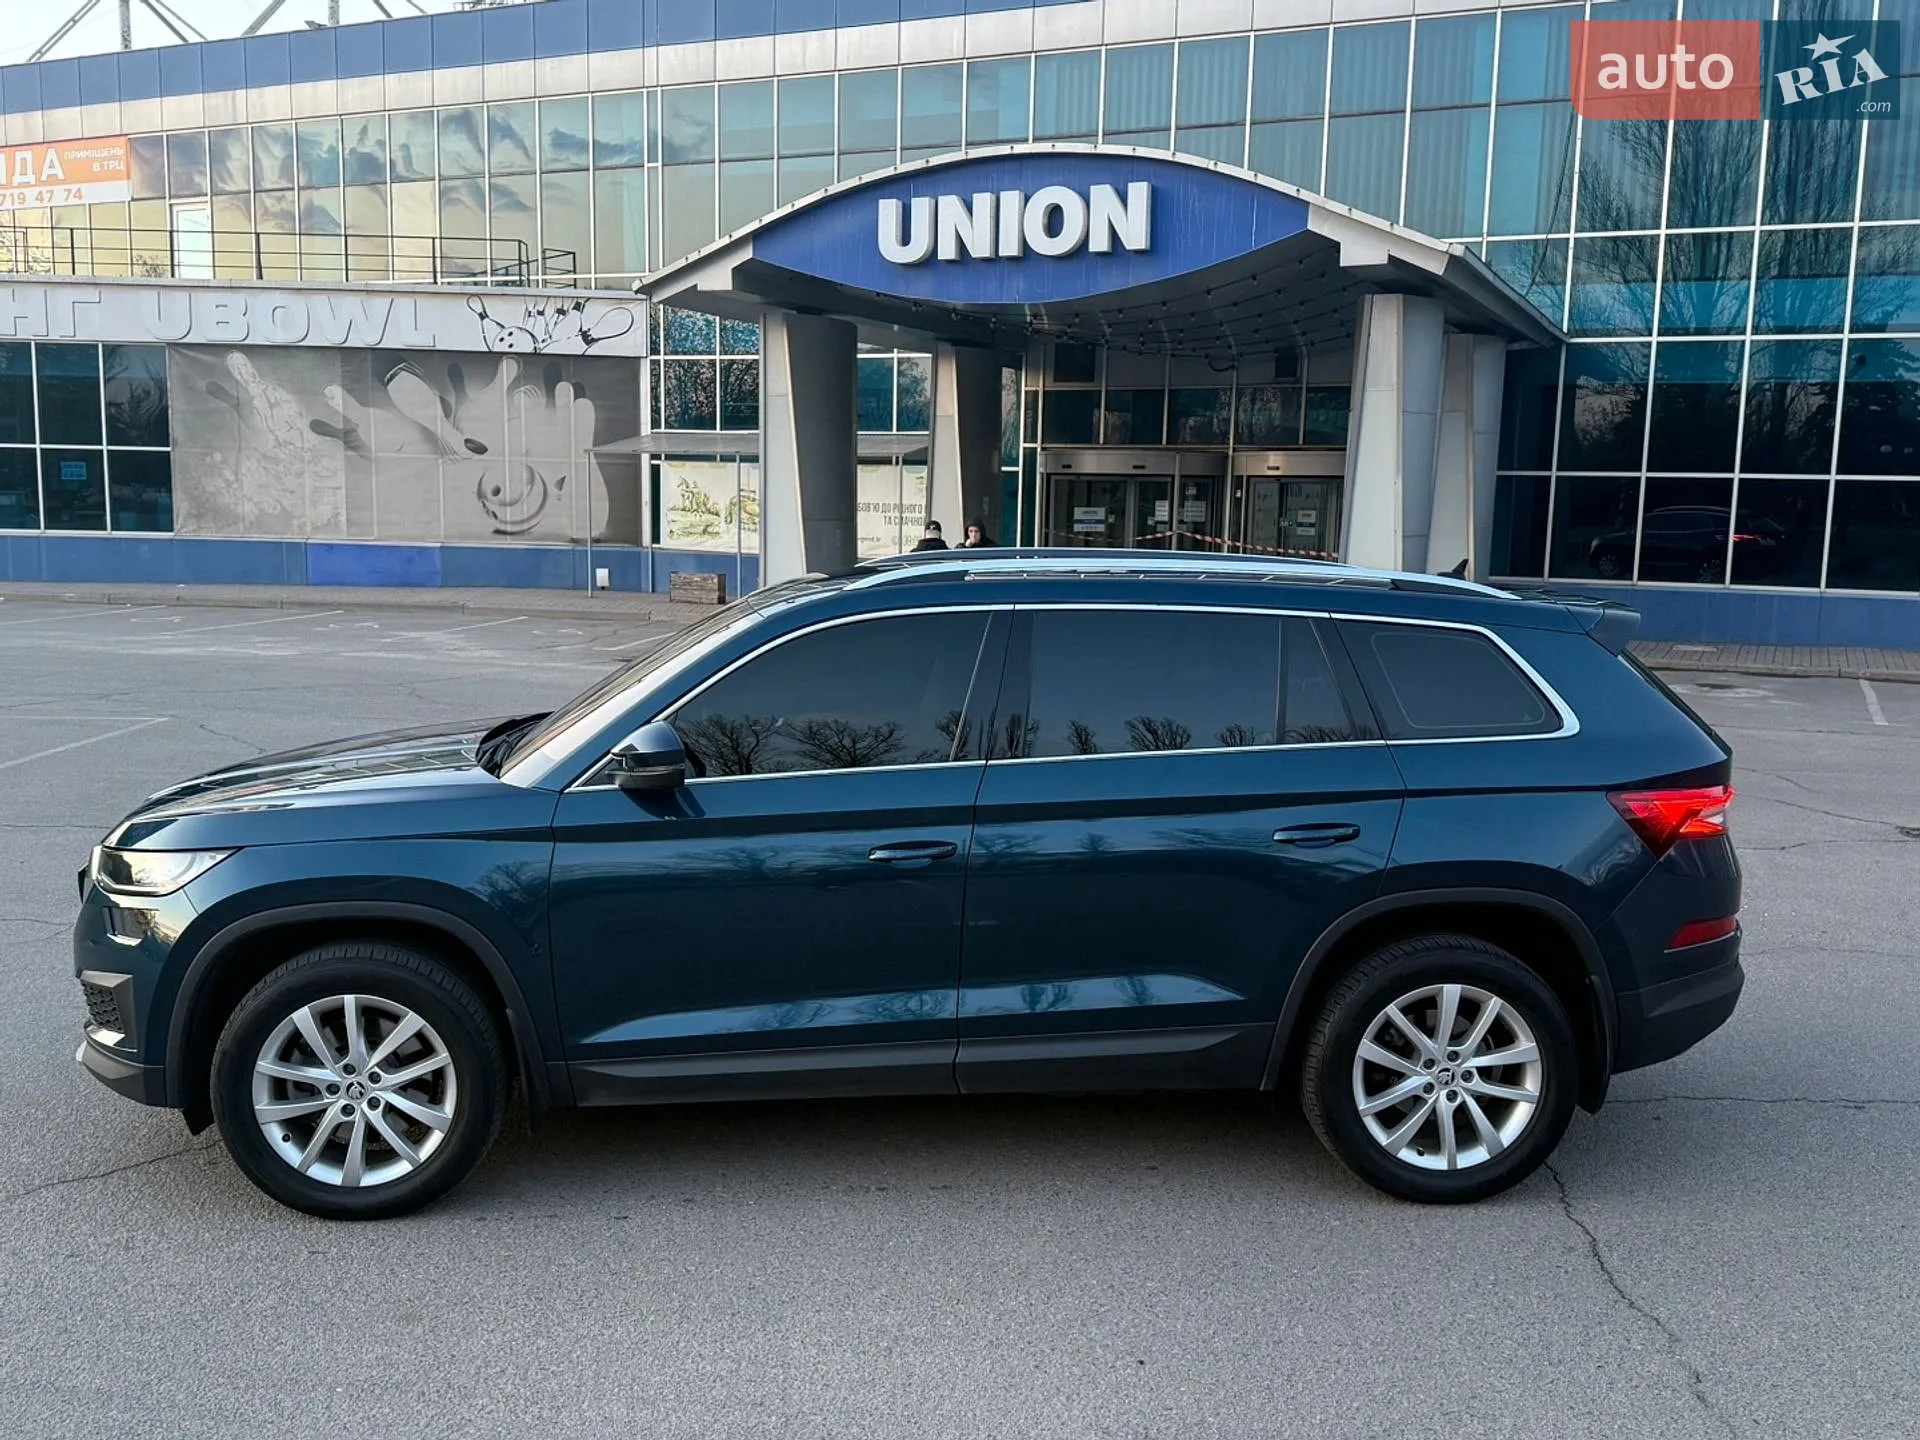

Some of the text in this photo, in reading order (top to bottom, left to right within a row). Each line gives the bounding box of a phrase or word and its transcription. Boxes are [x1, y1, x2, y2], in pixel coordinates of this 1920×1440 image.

[64, 147, 124, 160] ПРИМІЩЕНЬ
[0, 147, 65, 187] ДА
[92, 160, 124, 172] В ТРЦ
[35, 190, 54, 203] 47
[64, 187, 83, 202] 74
[878, 181, 1152, 265] UNION
